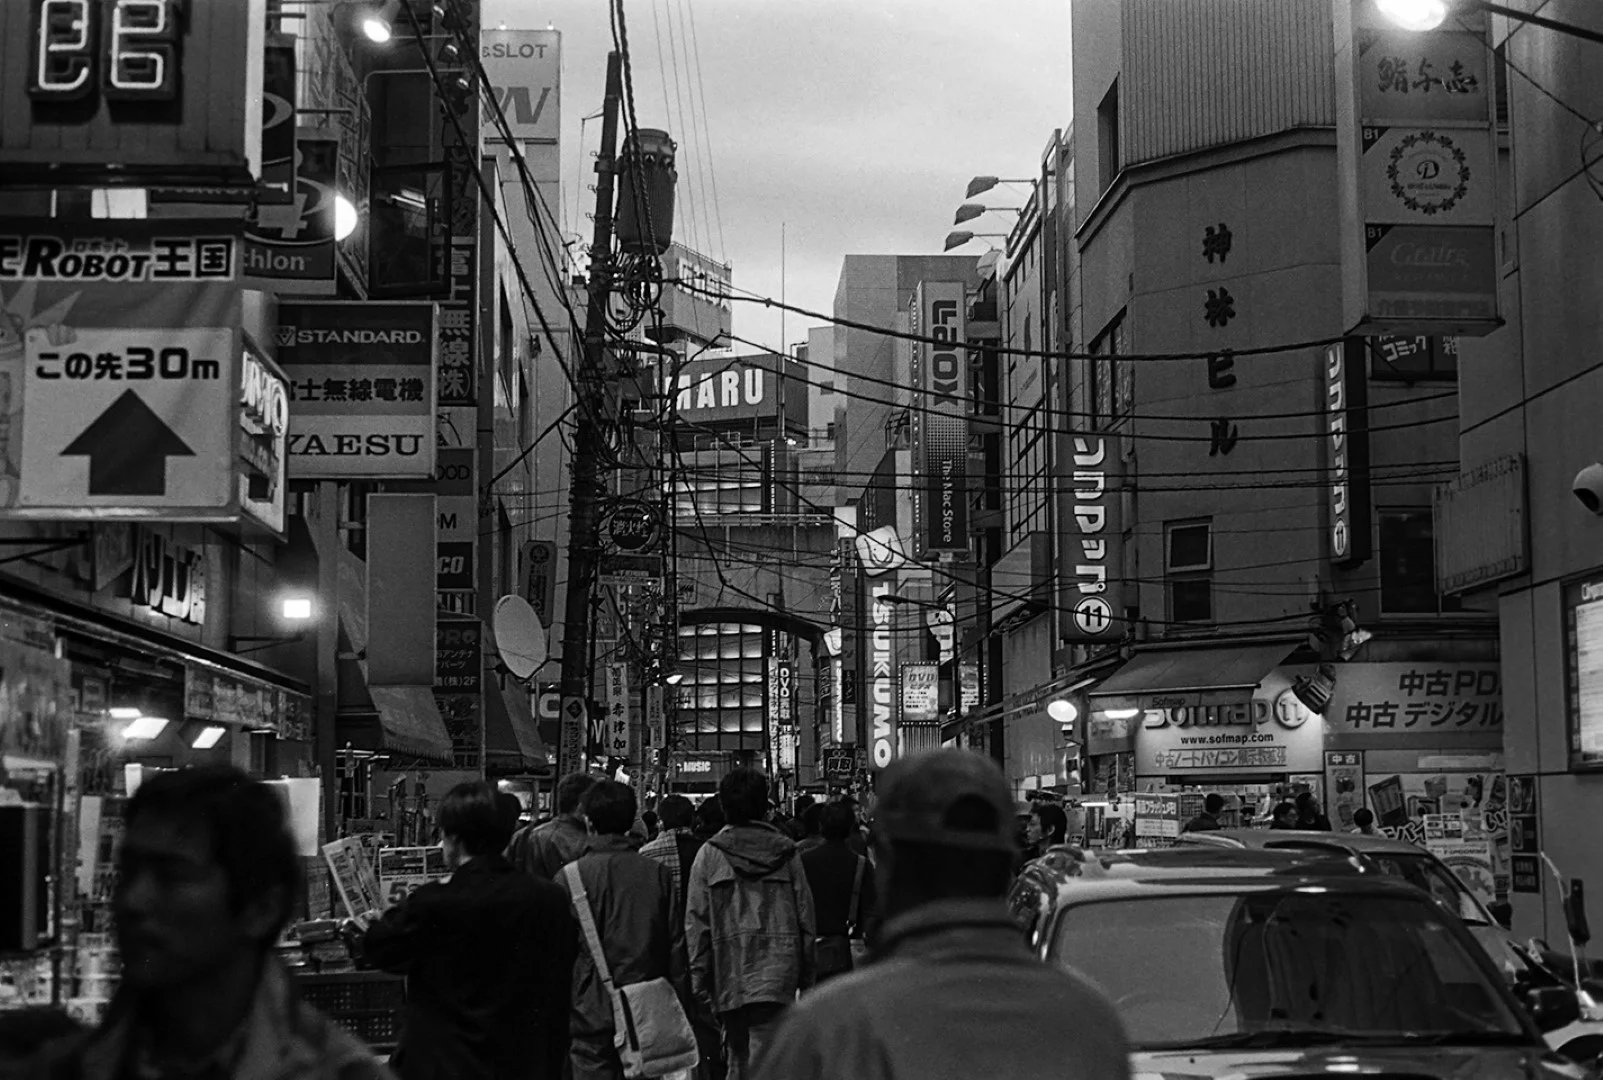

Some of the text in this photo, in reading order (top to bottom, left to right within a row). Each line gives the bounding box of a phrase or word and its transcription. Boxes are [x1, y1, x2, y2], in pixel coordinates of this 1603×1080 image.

[297, 330, 422, 344] STANDARD
[36, 346, 220, 381] この先30m
[288, 434, 424, 456] YAESU
[942, 508, 953, 543] Store
[872, 581, 892, 768] TSUKUMO
[1399, 669, 1502, 697] 中古PD
[1346, 701, 1399, 729] 中古
[1181, 732, 1274, 746] www.sofmap.com
